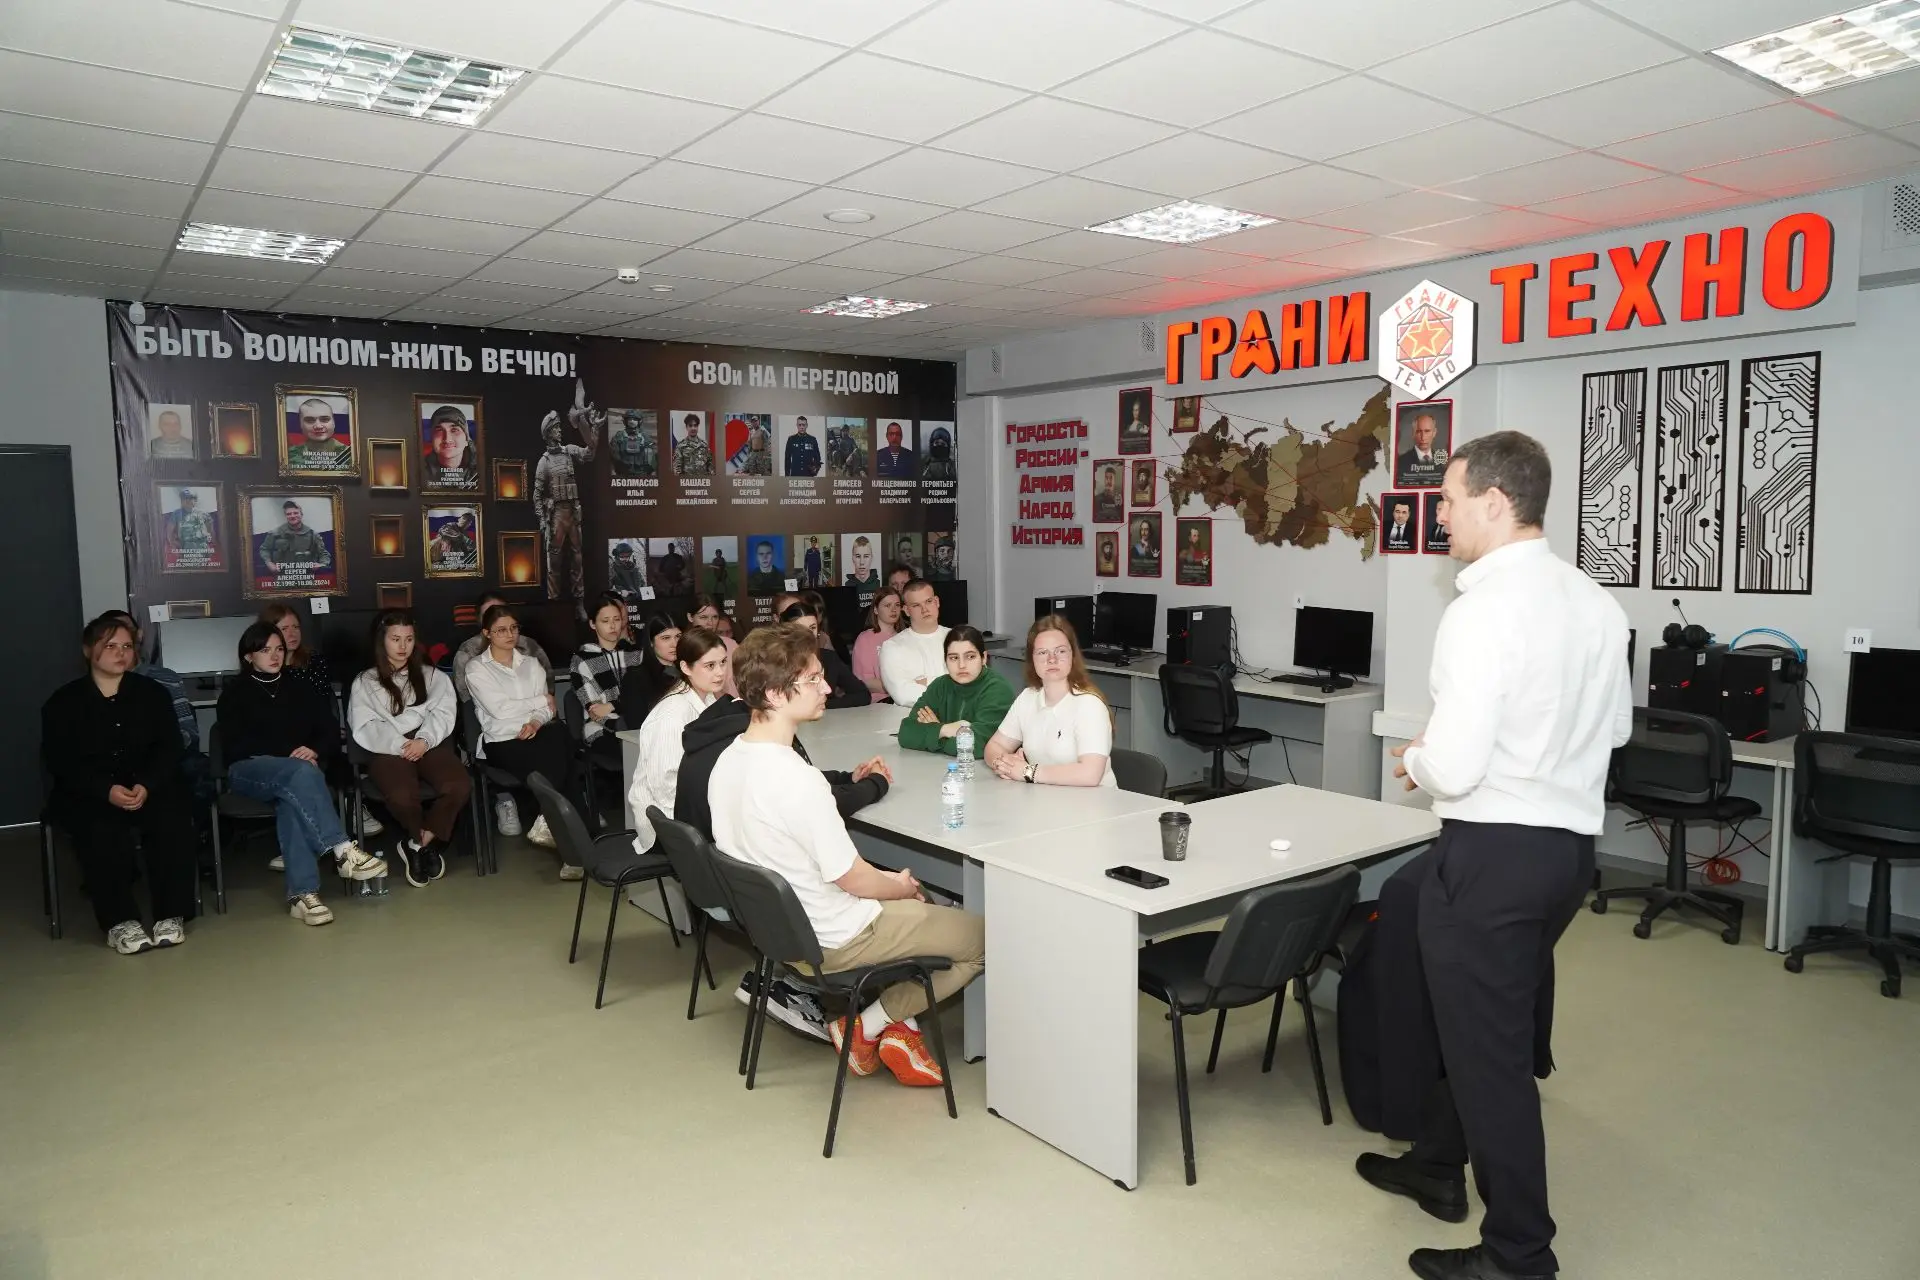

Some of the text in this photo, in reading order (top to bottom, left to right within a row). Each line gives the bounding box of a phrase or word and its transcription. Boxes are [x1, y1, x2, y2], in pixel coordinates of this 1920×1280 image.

[1166, 212, 1835, 385] ГРАНИ ТЕХНО
[1395, 288, 1459, 320] ГРАНИ
[135, 325, 233, 359] БЫТЬ
[481, 347, 577, 378] ВЕЧНО!
[749, 364, 777, 388] НА
[783, 366, 899, 396] ПЕРЕДОВОЙ
[1395, 360, 1456, 391] ТЕХНО
[1007, 420, 1088, 444] ГОРДОСТЬ
[1016, 447, 1078, 468] РОССИИ
[1410, 464, 1435, 473] Путин
[611, 478, 659, 487] АБОЛМАСОВ
[679, 478, 711, 487] КАШАЕВ
[833, 479, 862, 488] ЕЛИСЕЕВ
[921, 480, 954, 488] ГЕРОНТЬЕВ
[1020, 474, 1074, 493] АРМИЯ
[626, 489, 644, 497] ИЛЬЯ
[832, 489, 864, 497] АЛЕКСАНДР
[676, 498, 718, 506] МИХАЙЛОВИЧ
[779, 498, 826, 506] АЛЕКСАНДРОВИЧ
[1020, 500, 1075, 520] НАРОД
[1012, 525, 1083, 545] ИСТОРИЯ
[276, 561, 314, 570] ЕРЫГАНОВ
[1852, 636, 1864, 645] 10
